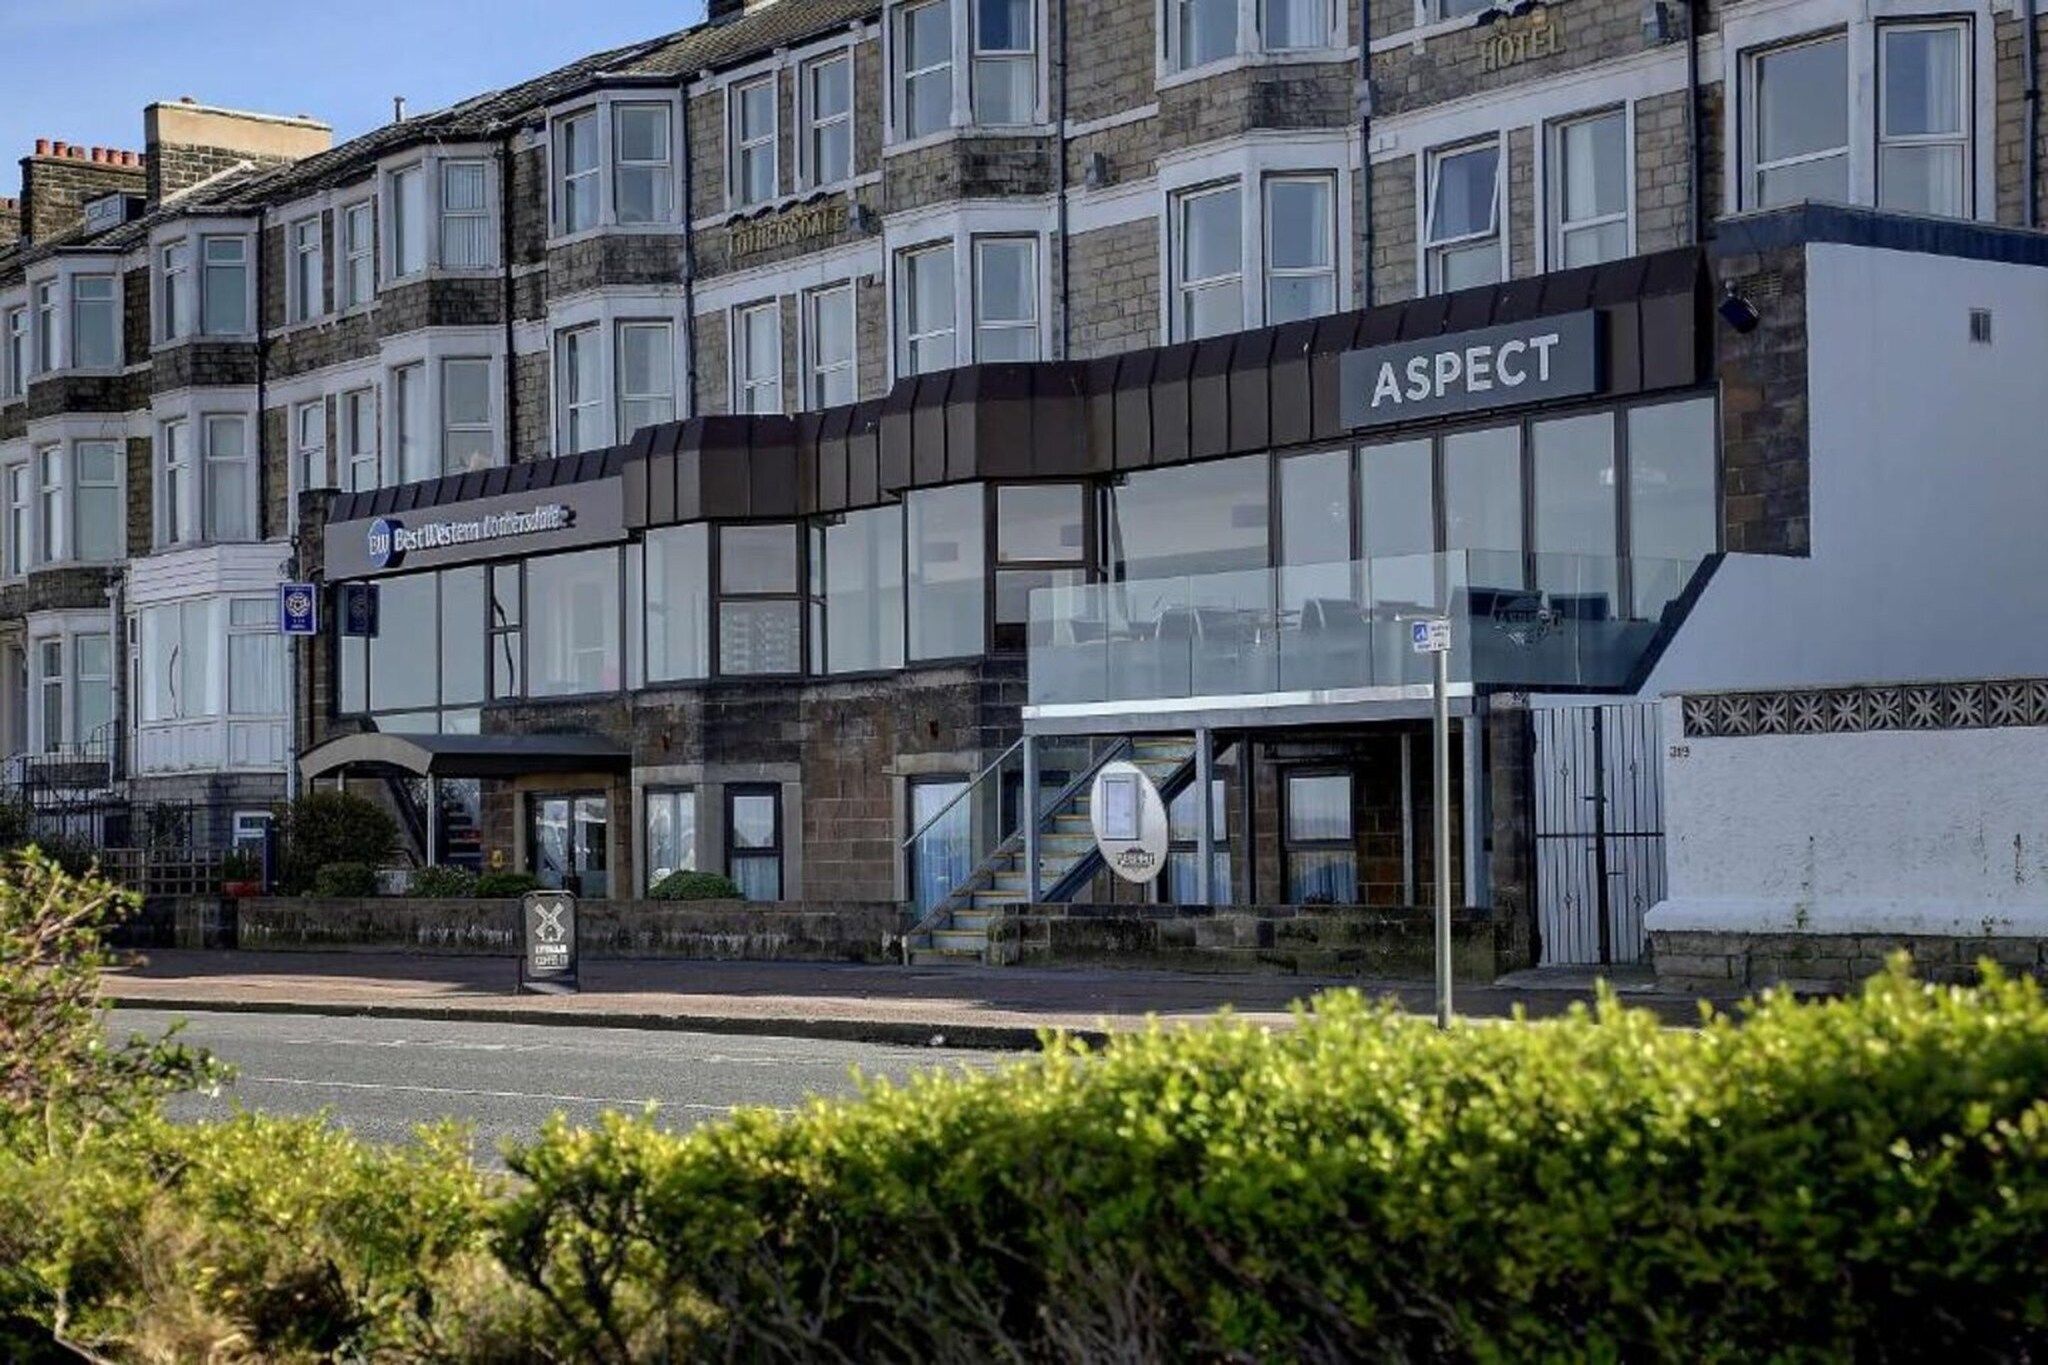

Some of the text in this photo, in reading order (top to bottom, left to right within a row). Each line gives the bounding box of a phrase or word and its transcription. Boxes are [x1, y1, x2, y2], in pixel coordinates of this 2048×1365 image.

[1480, 21, 1564, 72] HOTEL
[1371, 333, 1559, 408] ASPECT
[394, 528, 424, 552] Best
[424, 522, 479, 548] Western
